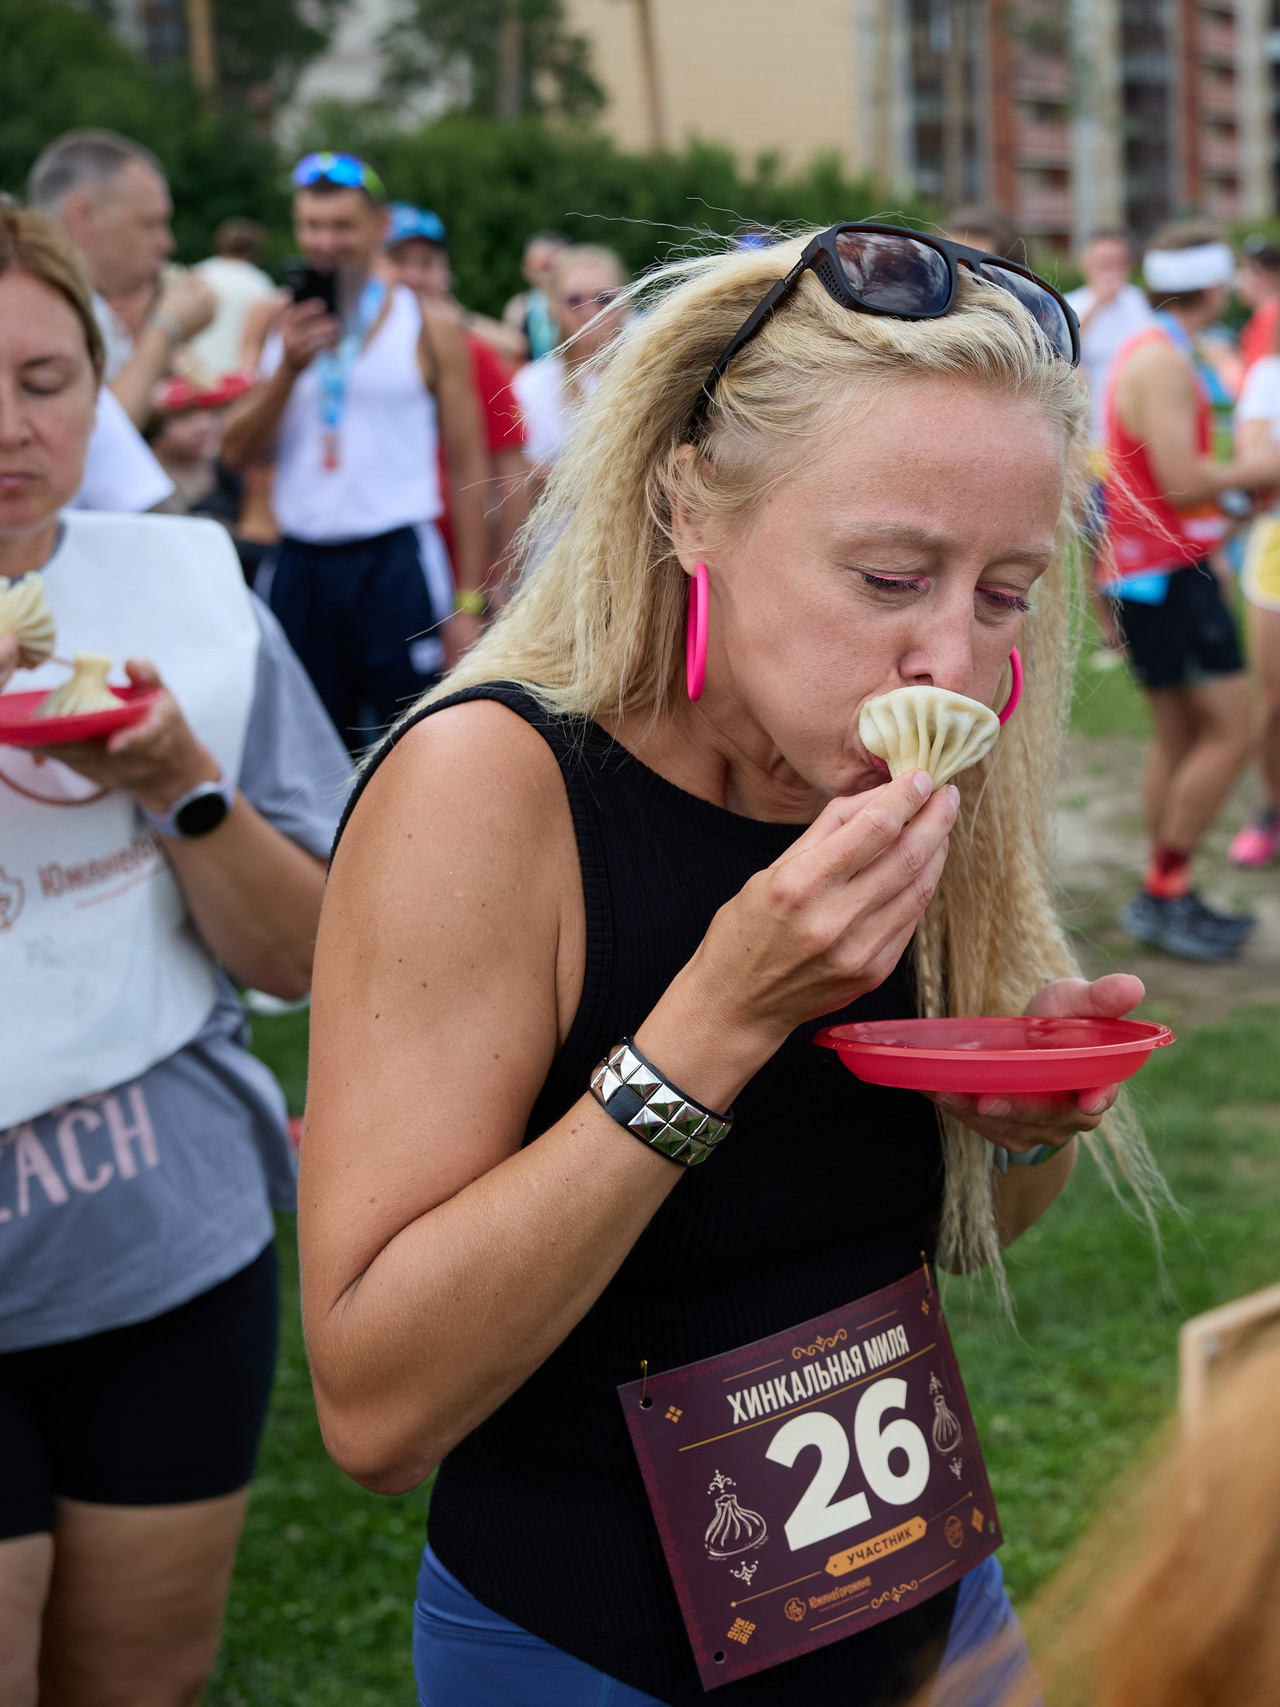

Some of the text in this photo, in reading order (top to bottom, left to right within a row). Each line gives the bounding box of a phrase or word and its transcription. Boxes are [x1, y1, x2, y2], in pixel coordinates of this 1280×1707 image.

[726, 1324, 910, 1424] ХИНКАЛЬНАЯ МИЛЯ
[765, 1377, 930, 1551] 26
[846, 1526, 913, 1566] УЧАСТНИК
